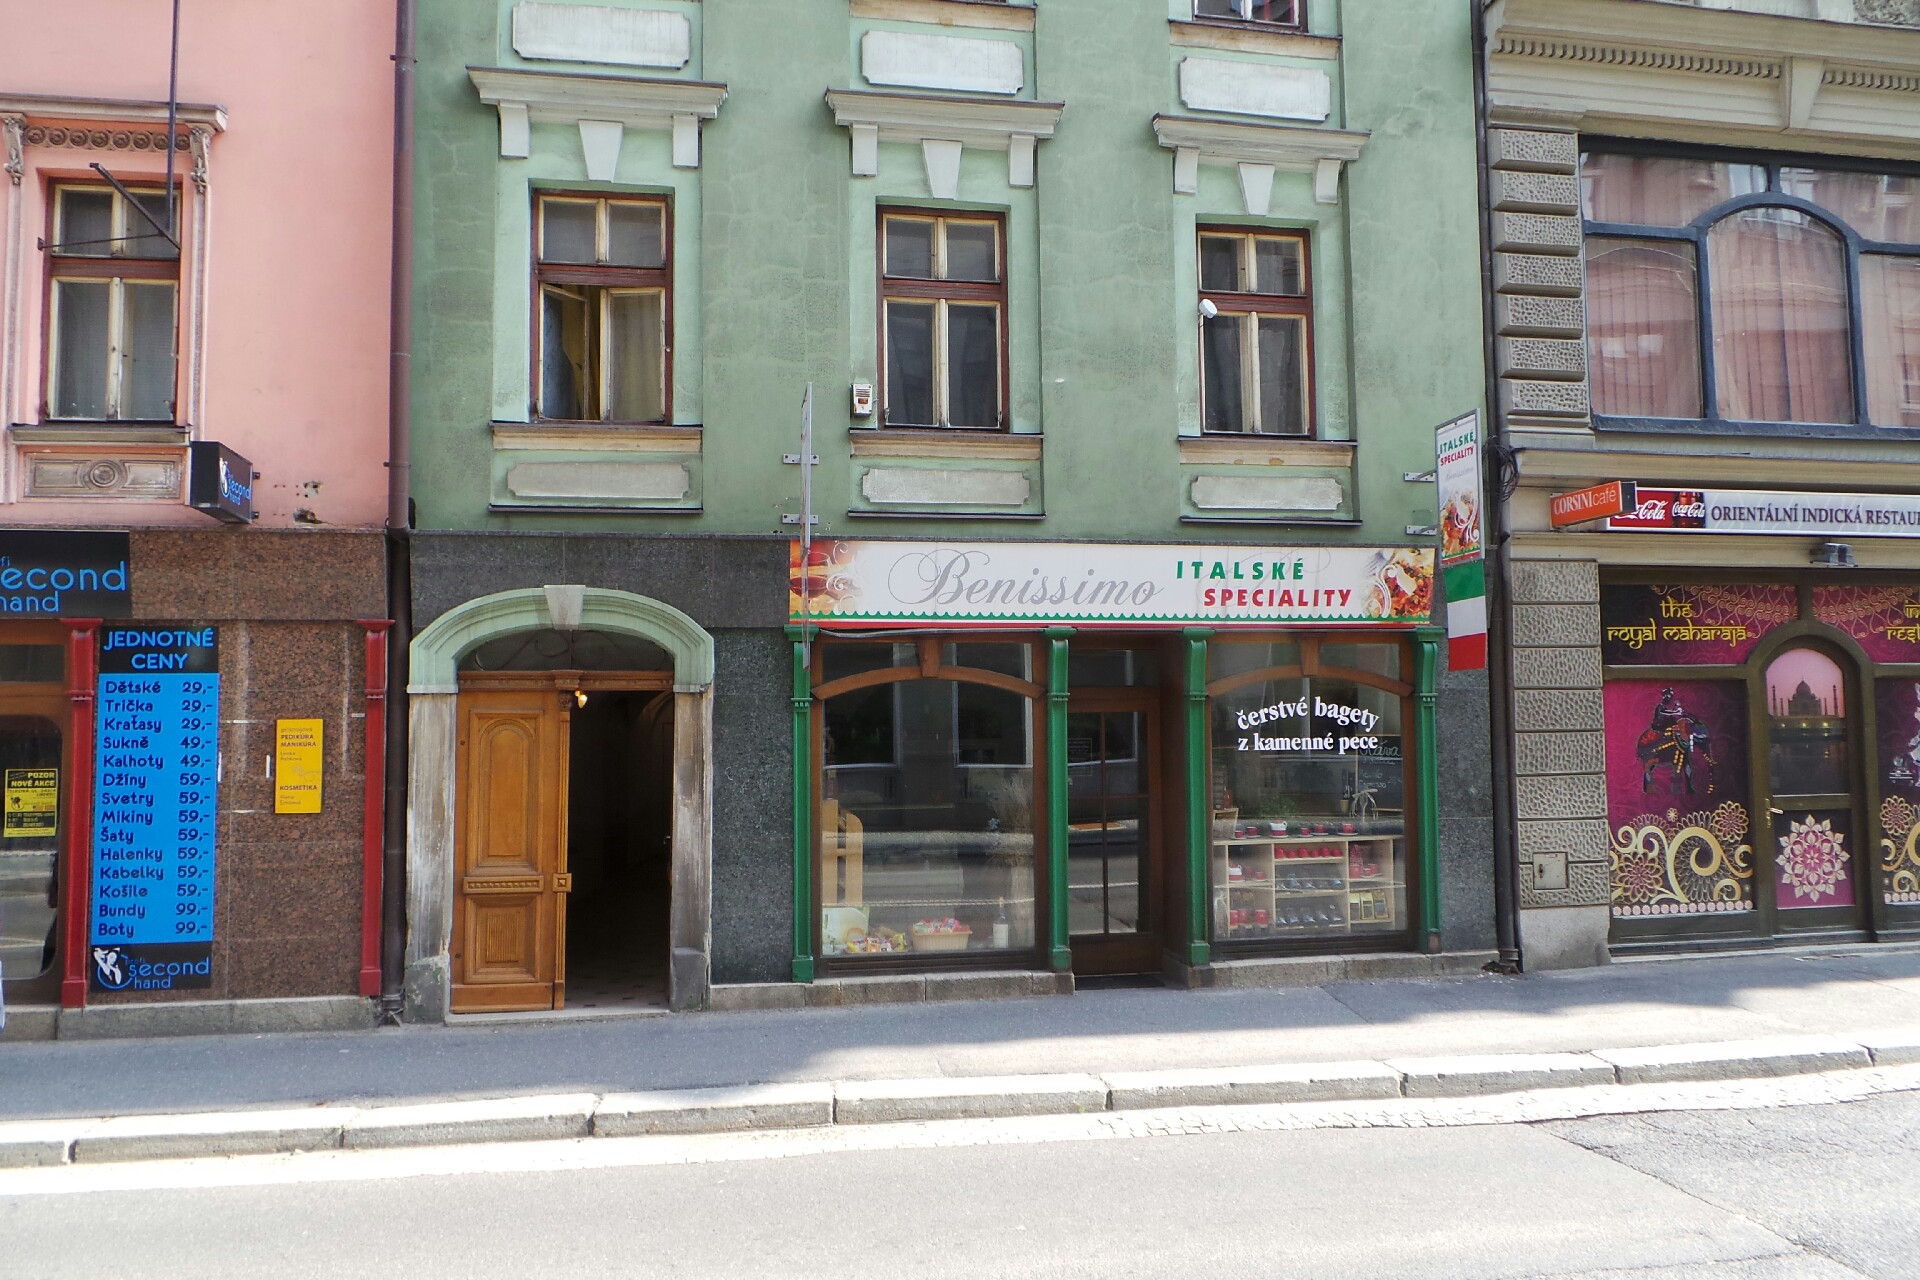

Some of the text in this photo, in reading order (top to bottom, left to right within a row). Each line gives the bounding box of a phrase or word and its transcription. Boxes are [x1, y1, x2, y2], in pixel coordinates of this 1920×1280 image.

[1440, 428, 1474, 455] ITALSKÉ
[1440, 445, 1475, 467] SPECIALITY
[1710, 502, 1799, 523] ORIENTÁLNÍ
[1802, 504, 1862, 524] INDICKÁ
[887, 548, 1165, 605] Benissimo
[1175, 557, 1305, 581] ITALSKÉ
[1203, 588, 1352, 608] SPECIALITY
[1659, 595, 1695, 618] the
[103, 627, 215, 651] JEDNOTNÉ
[1606, 618, 1748, 649] royal maharaja
[131, 653, 189, 670] CENY
[105, 681, 213, 694] Dětské 29,-
[104, 699, 213, 713] Trička 29,-
[1235, 695, 1380, 733] čerstvé bagety
[104, 714, 212, 733] Kraťasy 29,-
[103, 736, 212, 750] Sukně 49,-
[1237, 731, 1378, 755] z kamenné pece
[103, 754, 212, 770] Kalhoty 49,-
[11, 779, 56, 788] NOVÉ AKCE
[103, 773, 211, 789] Džíny 59,-
[102, 791, 211, 807] Svetry 59,-
[101, 810, 210, 826] Mikiny 59,-
[100, 826, 209, 845] Šaty 59,-
[100, 847, 209, 863] Halenky 59,-
[100, 865, 209, 881] Kabelky 59,-
[99, 884, 208, 899] Košile 59,-
[99, 902, 208, 919] Bundy 99,-
[98, 921, 208, 939] Boty 99,-
[129, 956, 210, 977] second
[134, 975, 172, 989] hand
